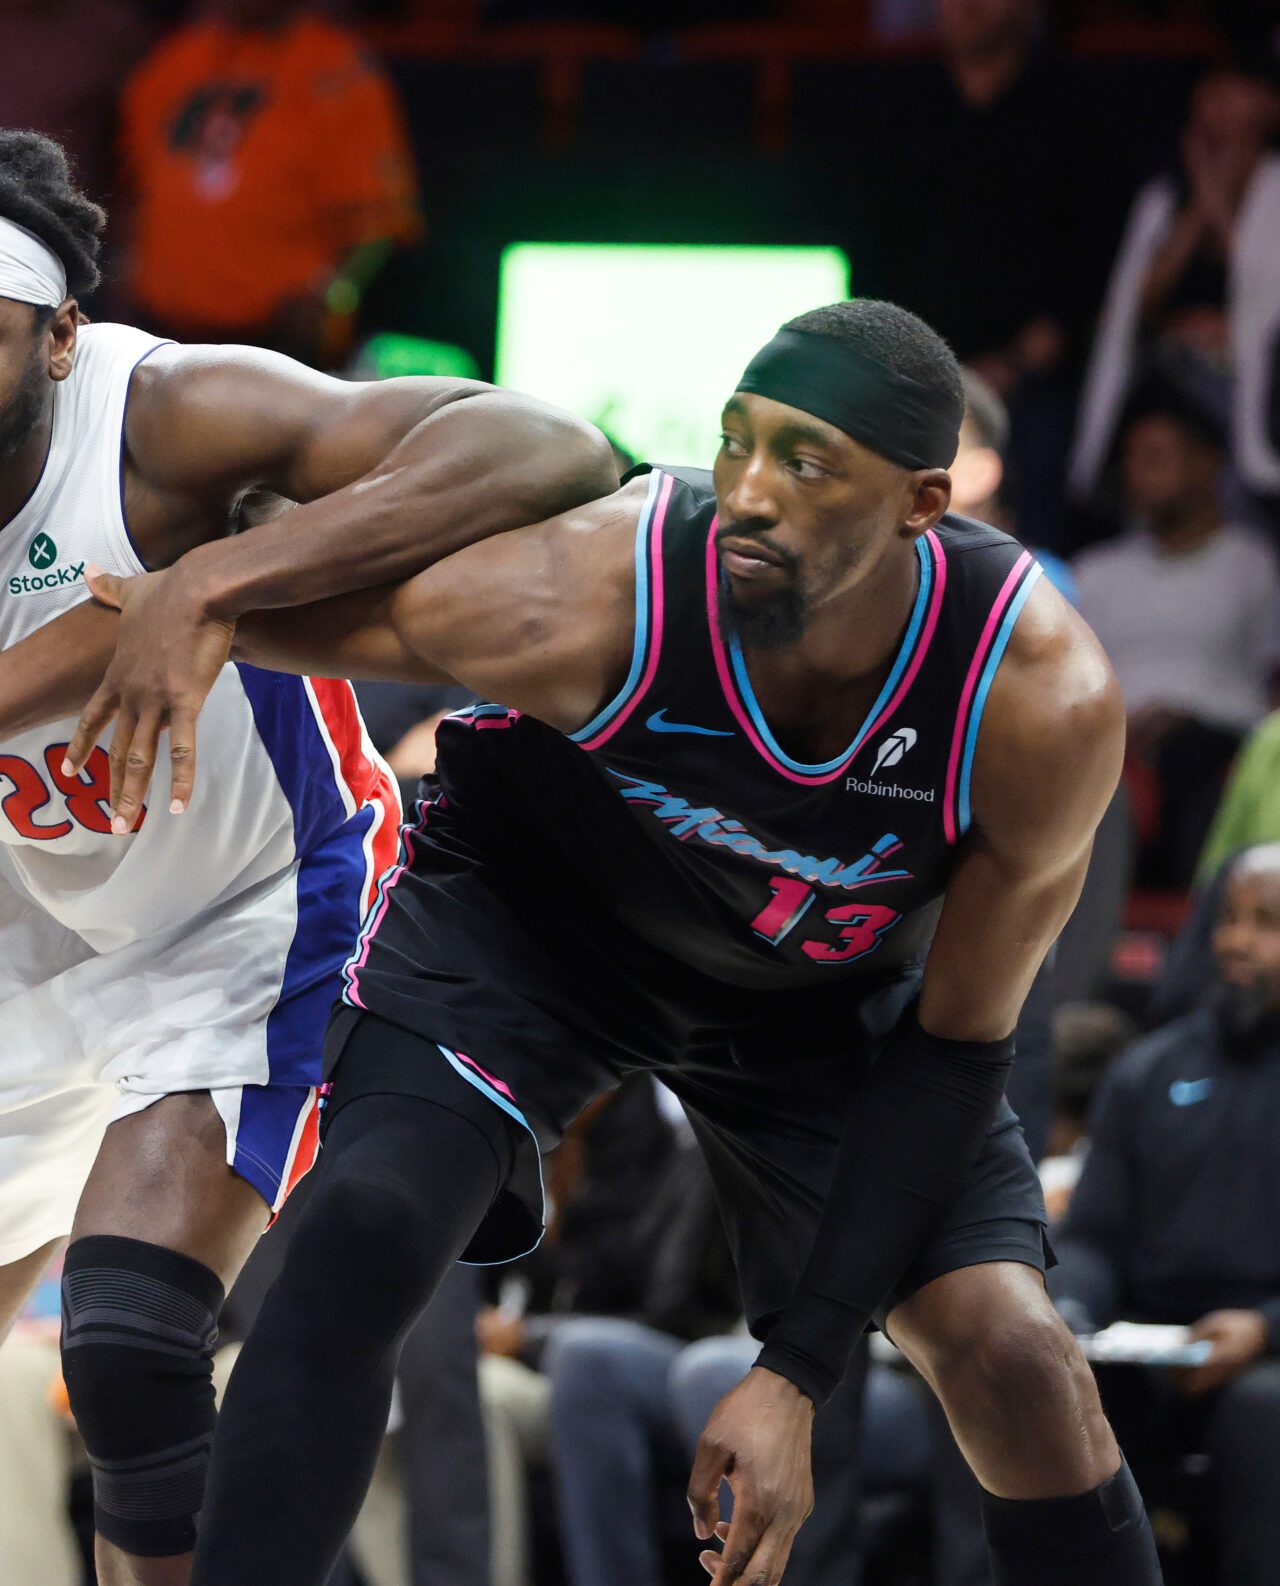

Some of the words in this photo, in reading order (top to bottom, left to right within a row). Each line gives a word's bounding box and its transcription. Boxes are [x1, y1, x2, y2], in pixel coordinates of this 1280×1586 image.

[9, 561, 85, 595] StockX
[845, 778, 934, 802] Robinhood
[605, 767, 914, 889] Miami
[750, 876, 903, 964] 13
